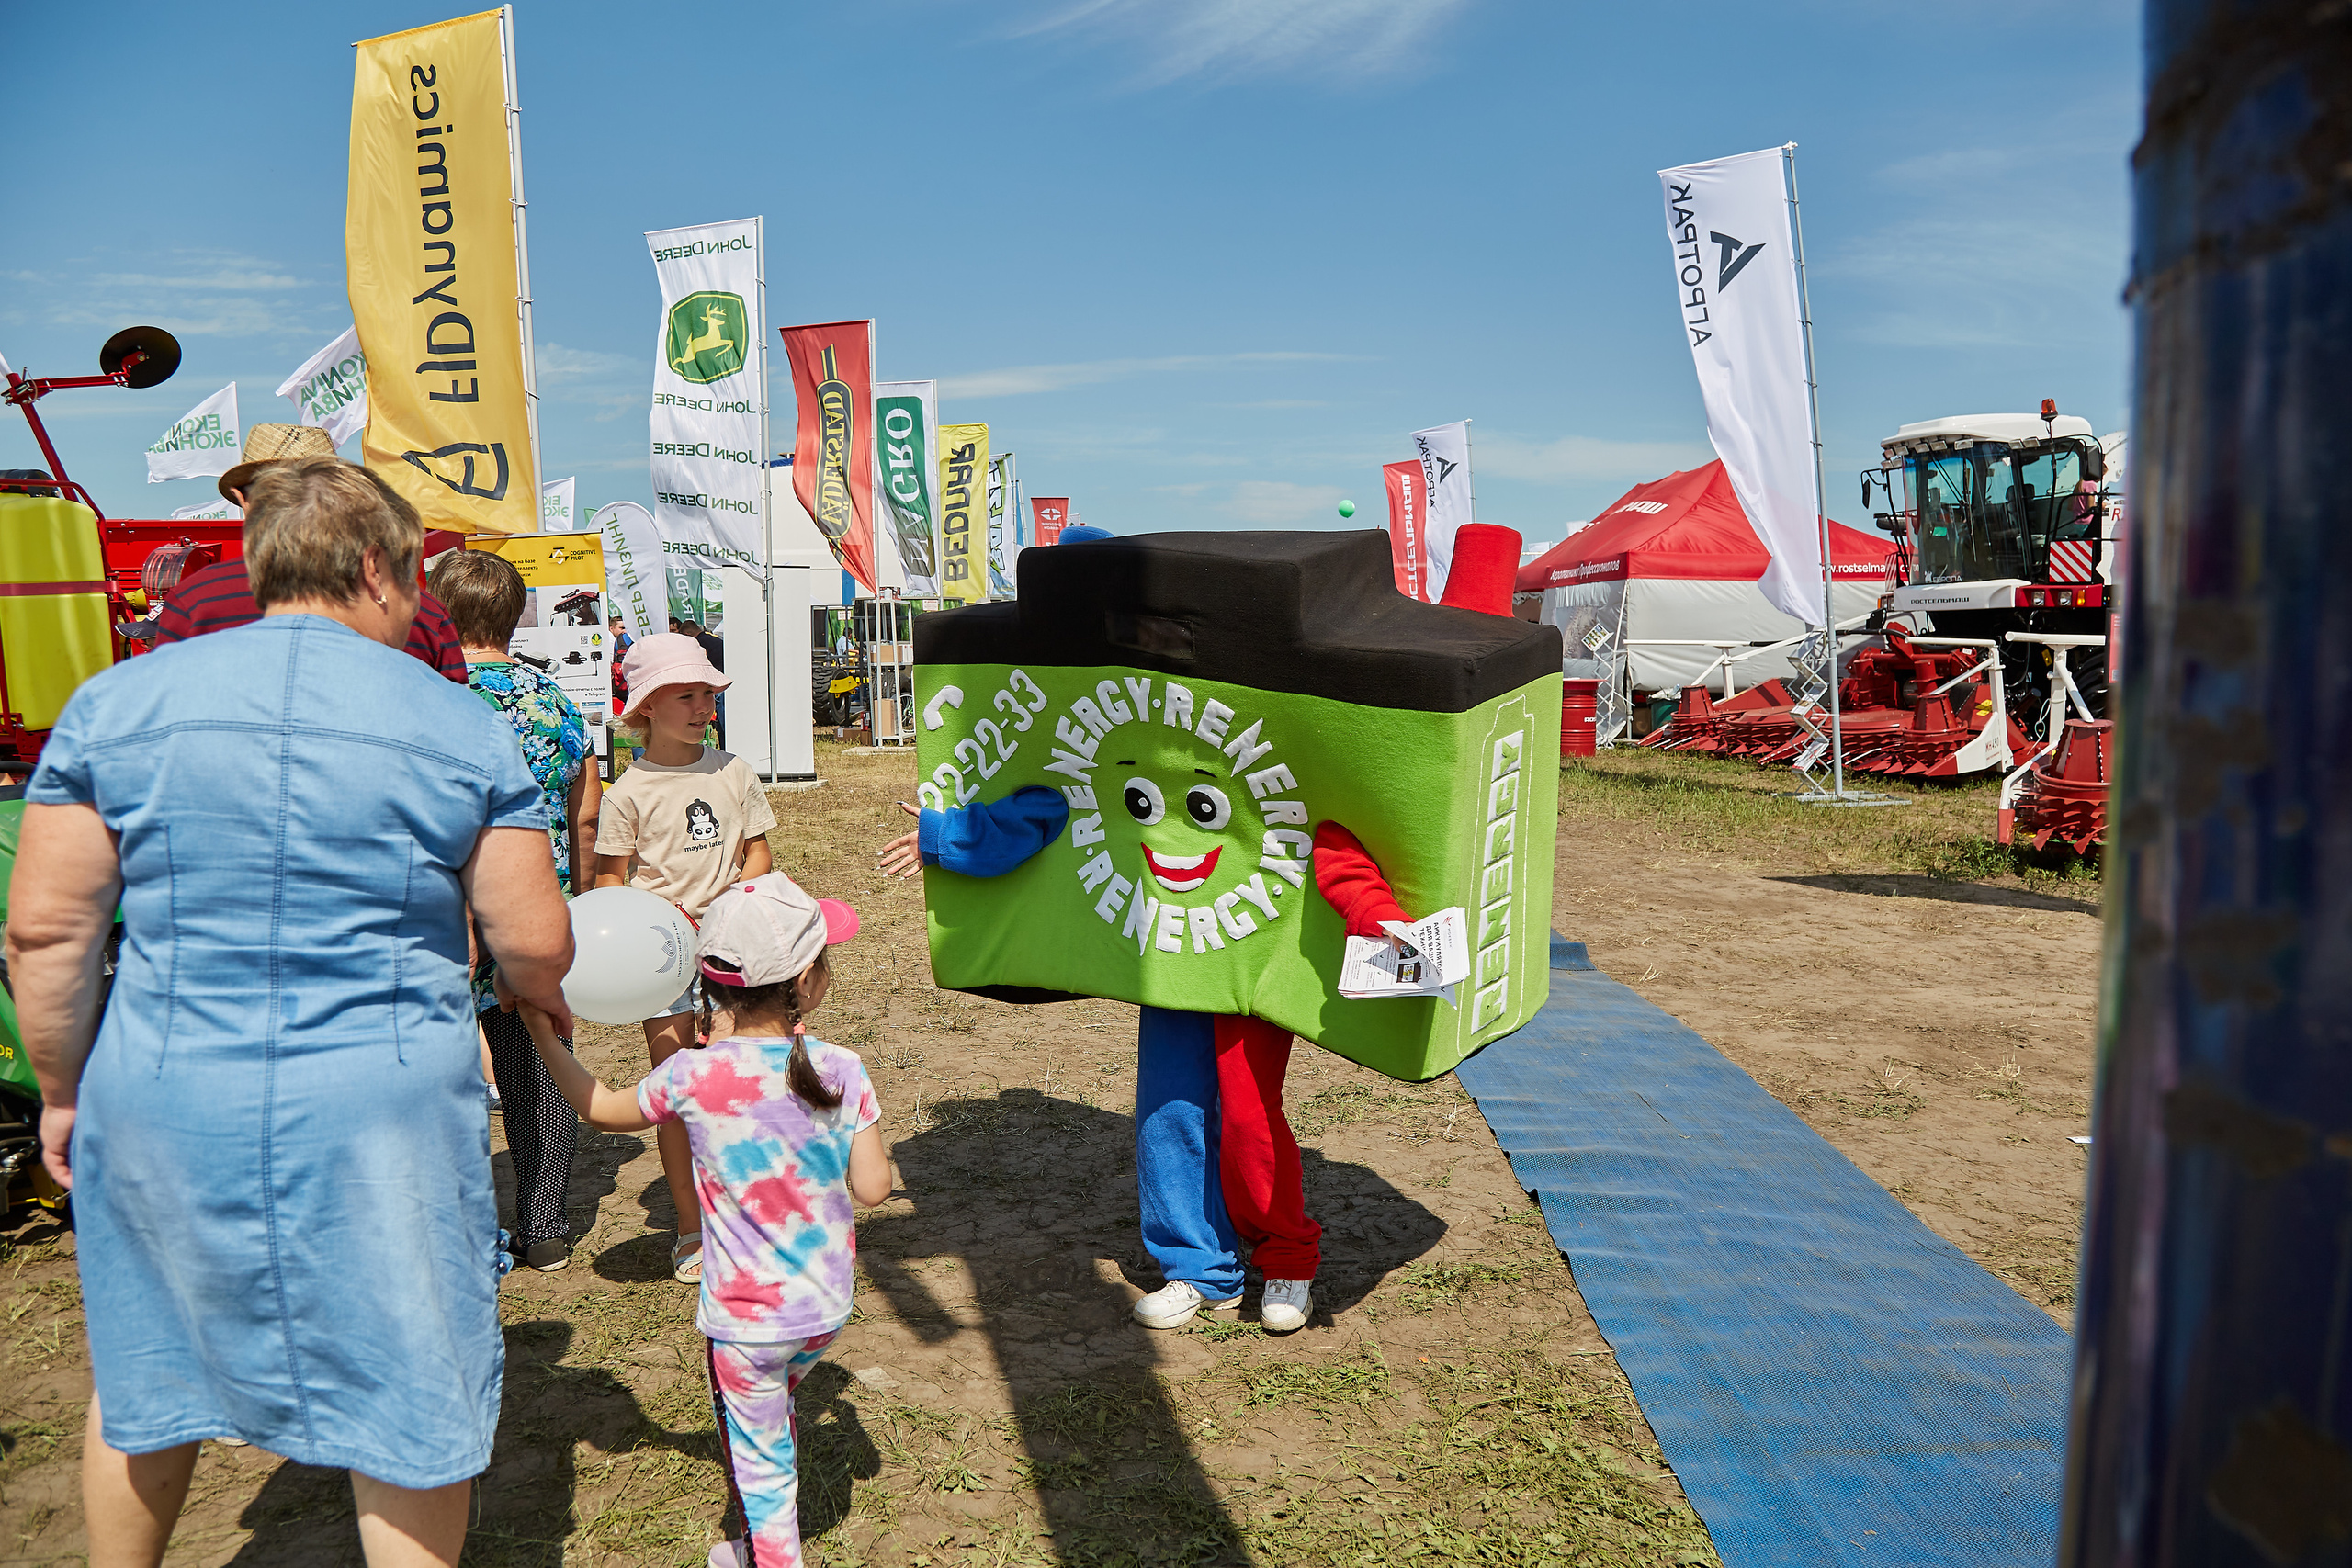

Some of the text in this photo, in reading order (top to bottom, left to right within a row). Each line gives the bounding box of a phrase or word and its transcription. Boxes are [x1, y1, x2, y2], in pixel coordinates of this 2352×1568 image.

[1910, 596, 1970, 604] РОСТСЕЛЬМАШ
[684, 839, 725, 852] maybe later
[1076, 848, 1280, 957] RENERGY
[1472, 730, 1524, 1035] RENERGY
